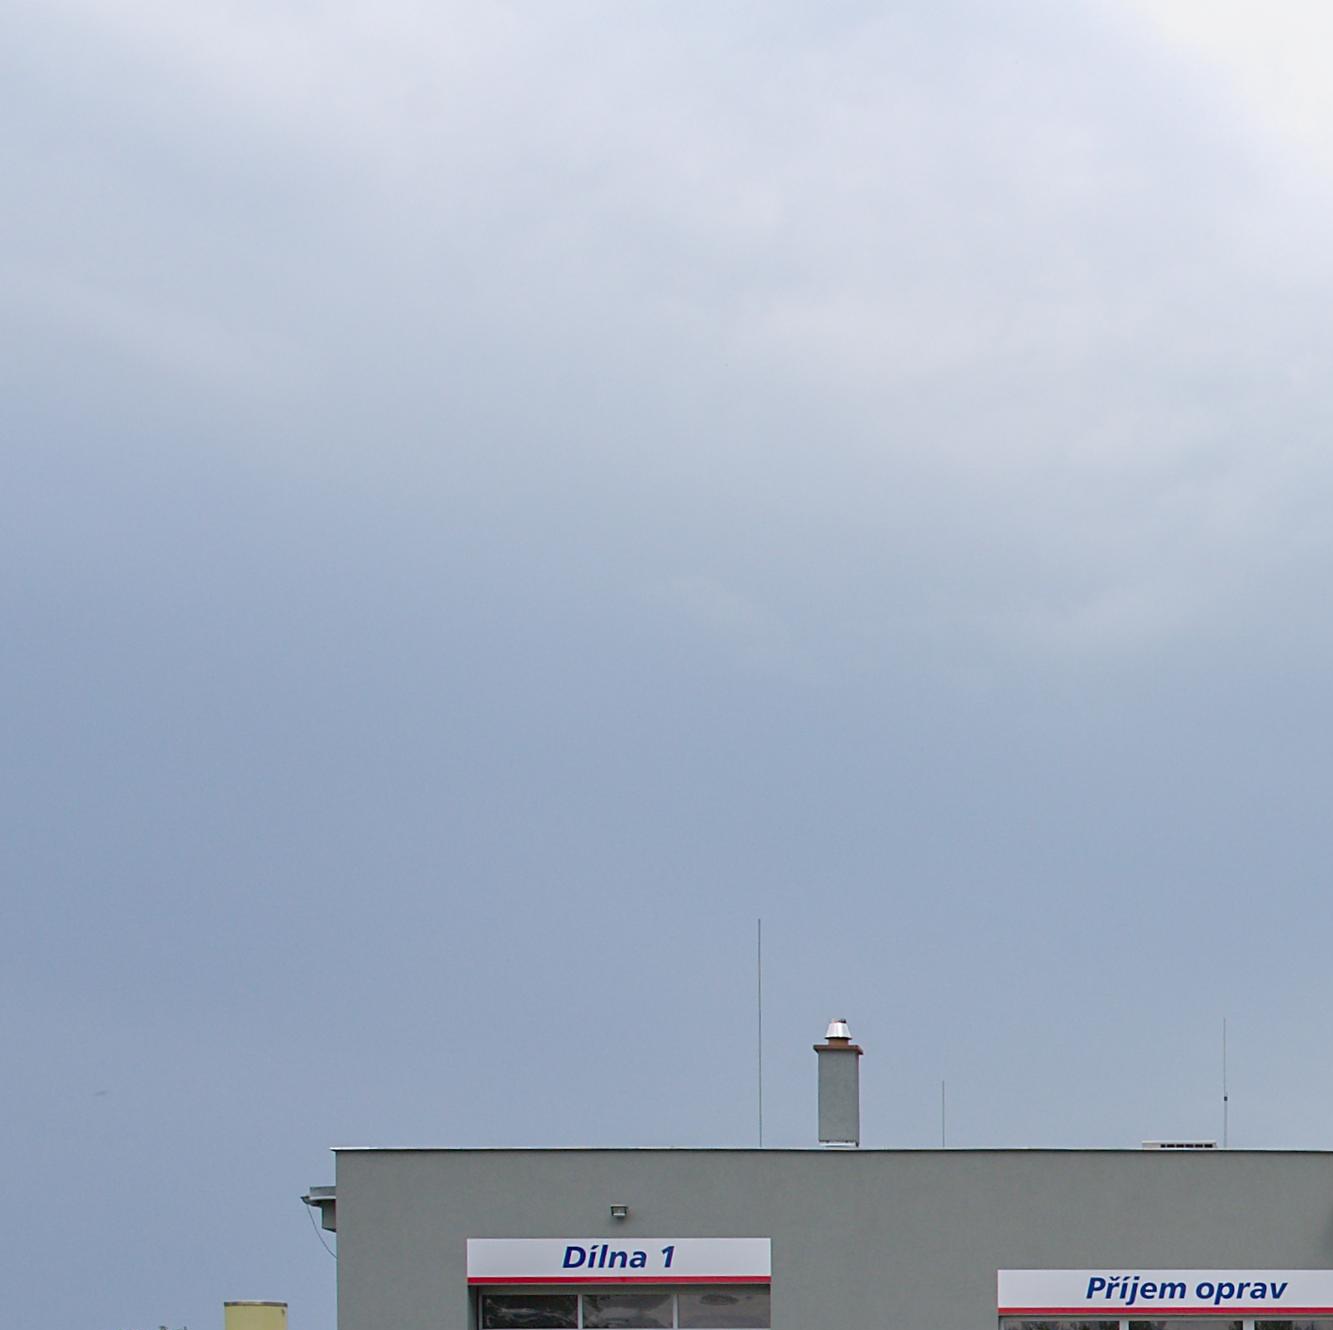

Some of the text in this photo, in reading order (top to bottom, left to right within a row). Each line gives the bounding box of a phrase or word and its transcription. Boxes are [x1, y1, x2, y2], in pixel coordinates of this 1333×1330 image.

[563, 1244, 675, 1268] Dílna 1
[1086, 1276, 1288, 1305] Příjem oprav
